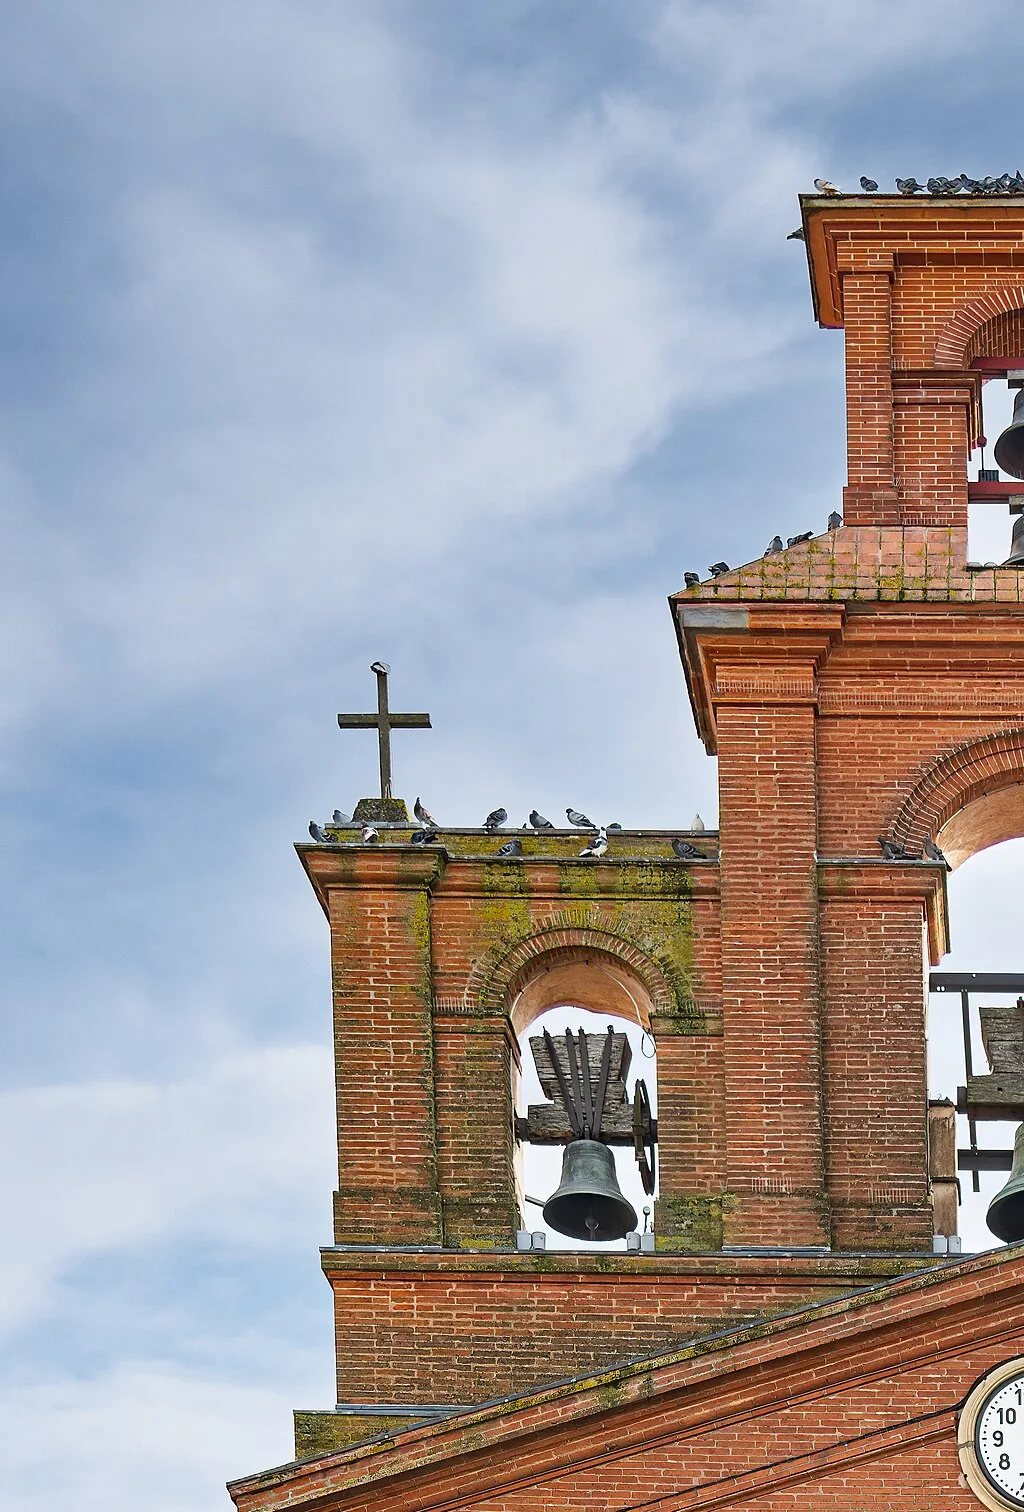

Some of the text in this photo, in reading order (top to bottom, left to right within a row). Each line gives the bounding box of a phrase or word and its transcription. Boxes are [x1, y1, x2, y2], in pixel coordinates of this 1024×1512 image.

[996, 1407, 1017, 1425] 10
[992, 1430, 1004, 1447] 9
[998, 1453, 1011, 1470] 8
